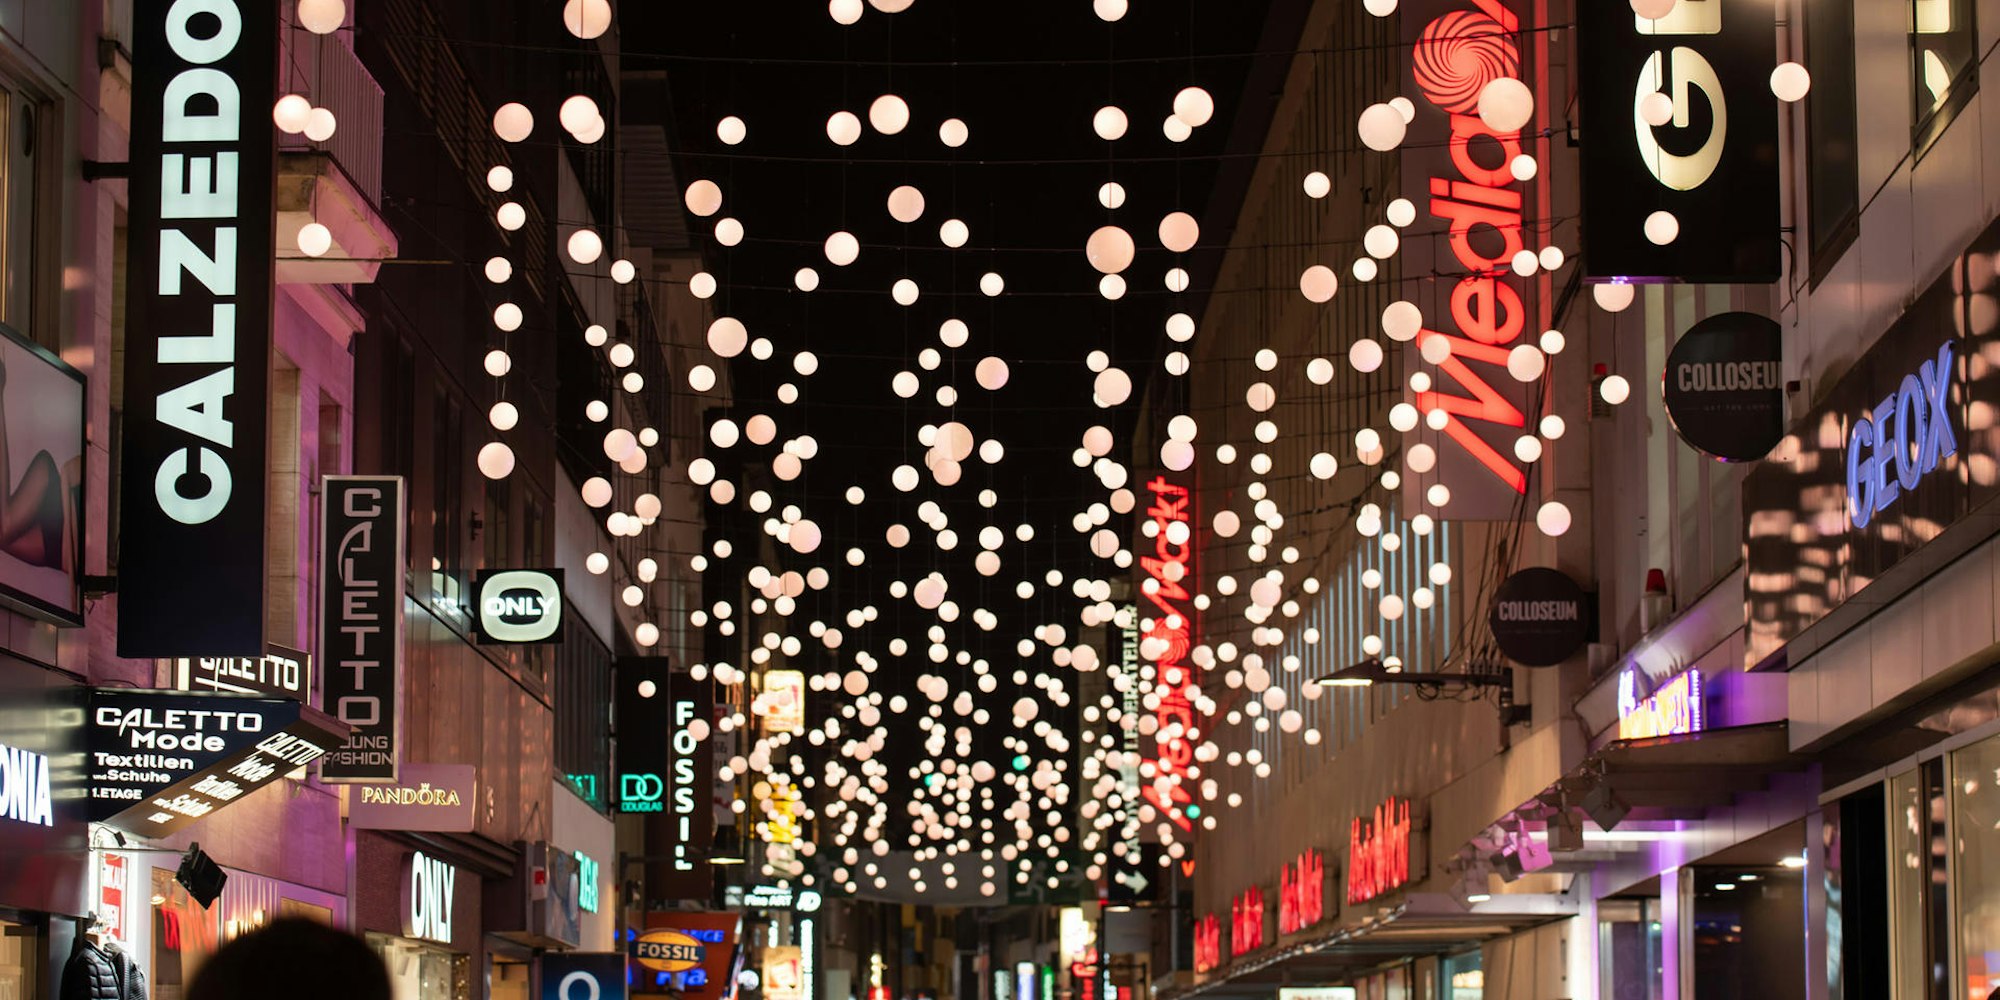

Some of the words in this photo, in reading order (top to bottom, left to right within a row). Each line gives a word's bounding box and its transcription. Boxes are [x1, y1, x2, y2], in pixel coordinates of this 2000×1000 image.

[154, 0, 243, 525] CALZEDO
[1415, 113, 1526, 496] Media
[1678, 361, 1782, 392] COLLOSEU
[1846, 339, 1958, 529] GEOX
[337, 487, 382, 726] CALETTO
[484, 596, 556, 617] ONLY
[1499, 601, 1578, 621] COLLOSEUM
[95, 707, 263, 737] CALETTO
[131, 729, 226, 752] Mode
[94, 751, 195, 770] Textilien
[323, 751, 394, 768] FASHION
[106, 769, 172, 784] Schuhe
[673, 700, 698, 871] FOSSIL
[91, 787, 143, 800] 1.ETAGE
[361, 783, 461, 806] PANDORA
[621, 801, 664, 812] DOUGLAS
[411, 851, 455, 944] ONLY
[637, 943, 700, 961] FOSSIL
